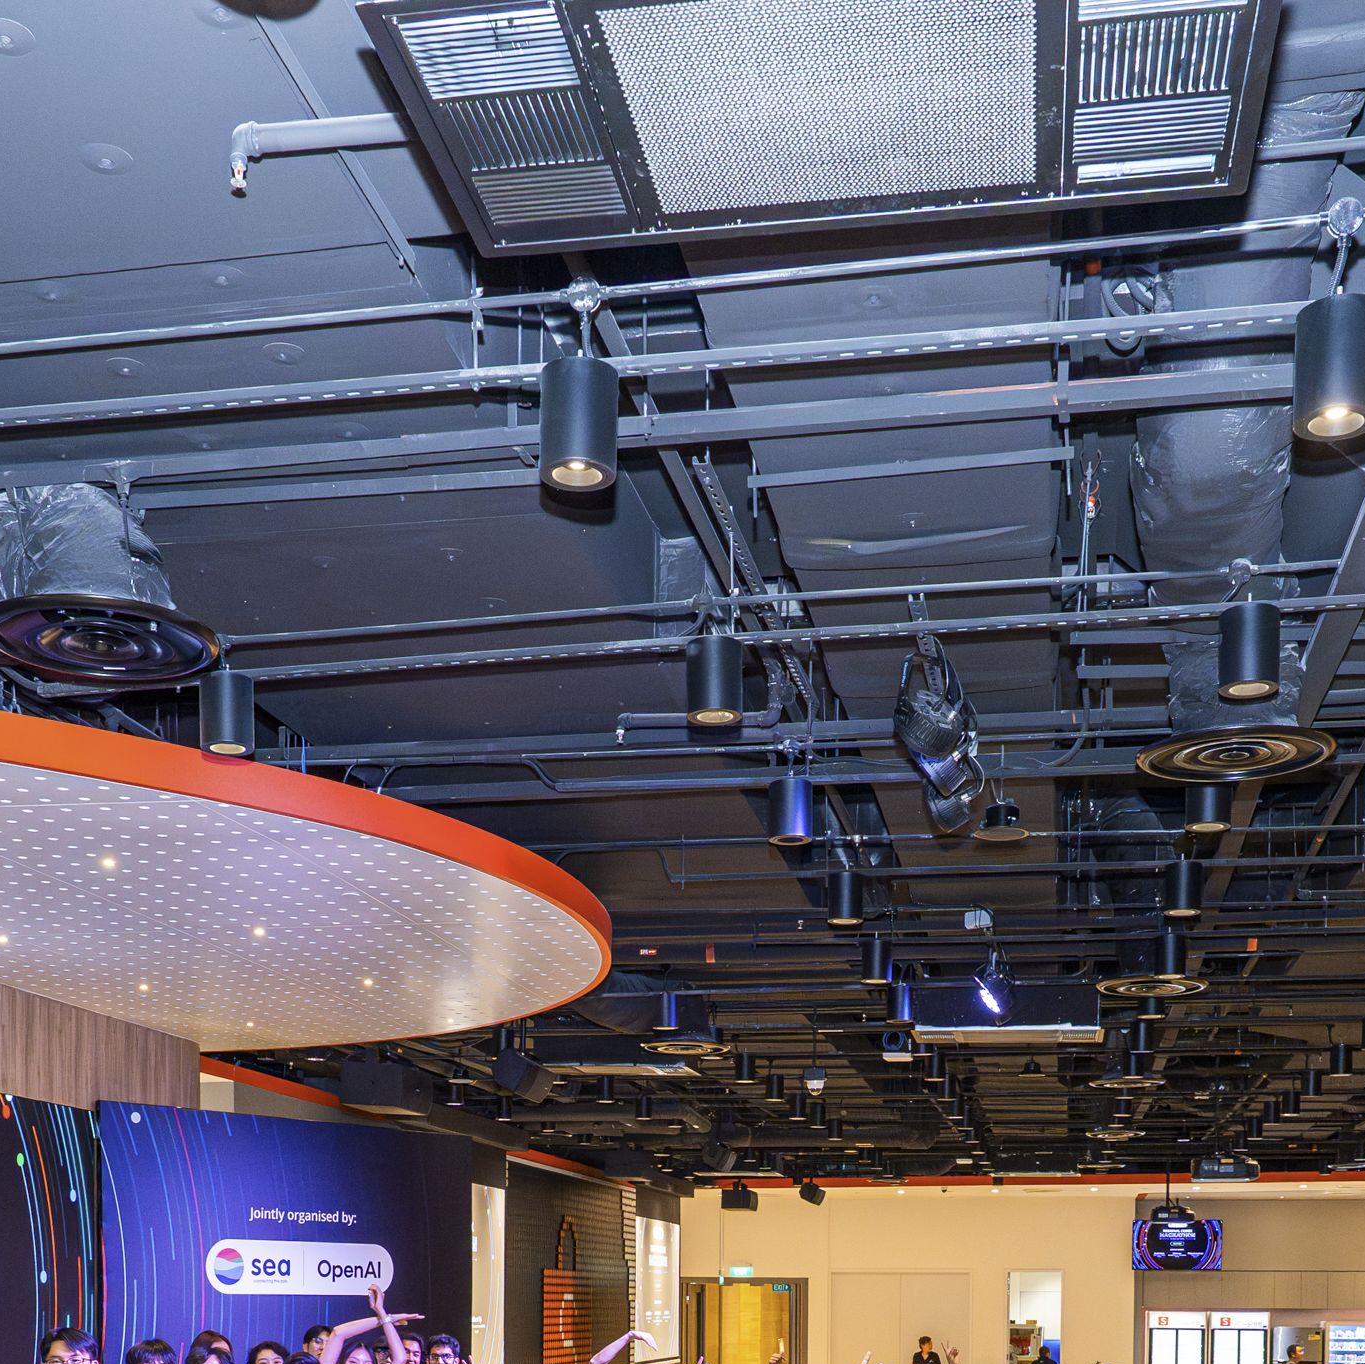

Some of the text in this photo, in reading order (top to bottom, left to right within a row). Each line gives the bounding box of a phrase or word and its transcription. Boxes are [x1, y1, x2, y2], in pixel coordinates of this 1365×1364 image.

[249, 1207, 357, 1225] Jointly organised by:
[251, 1258, 381, 1282] sea OpenAI
